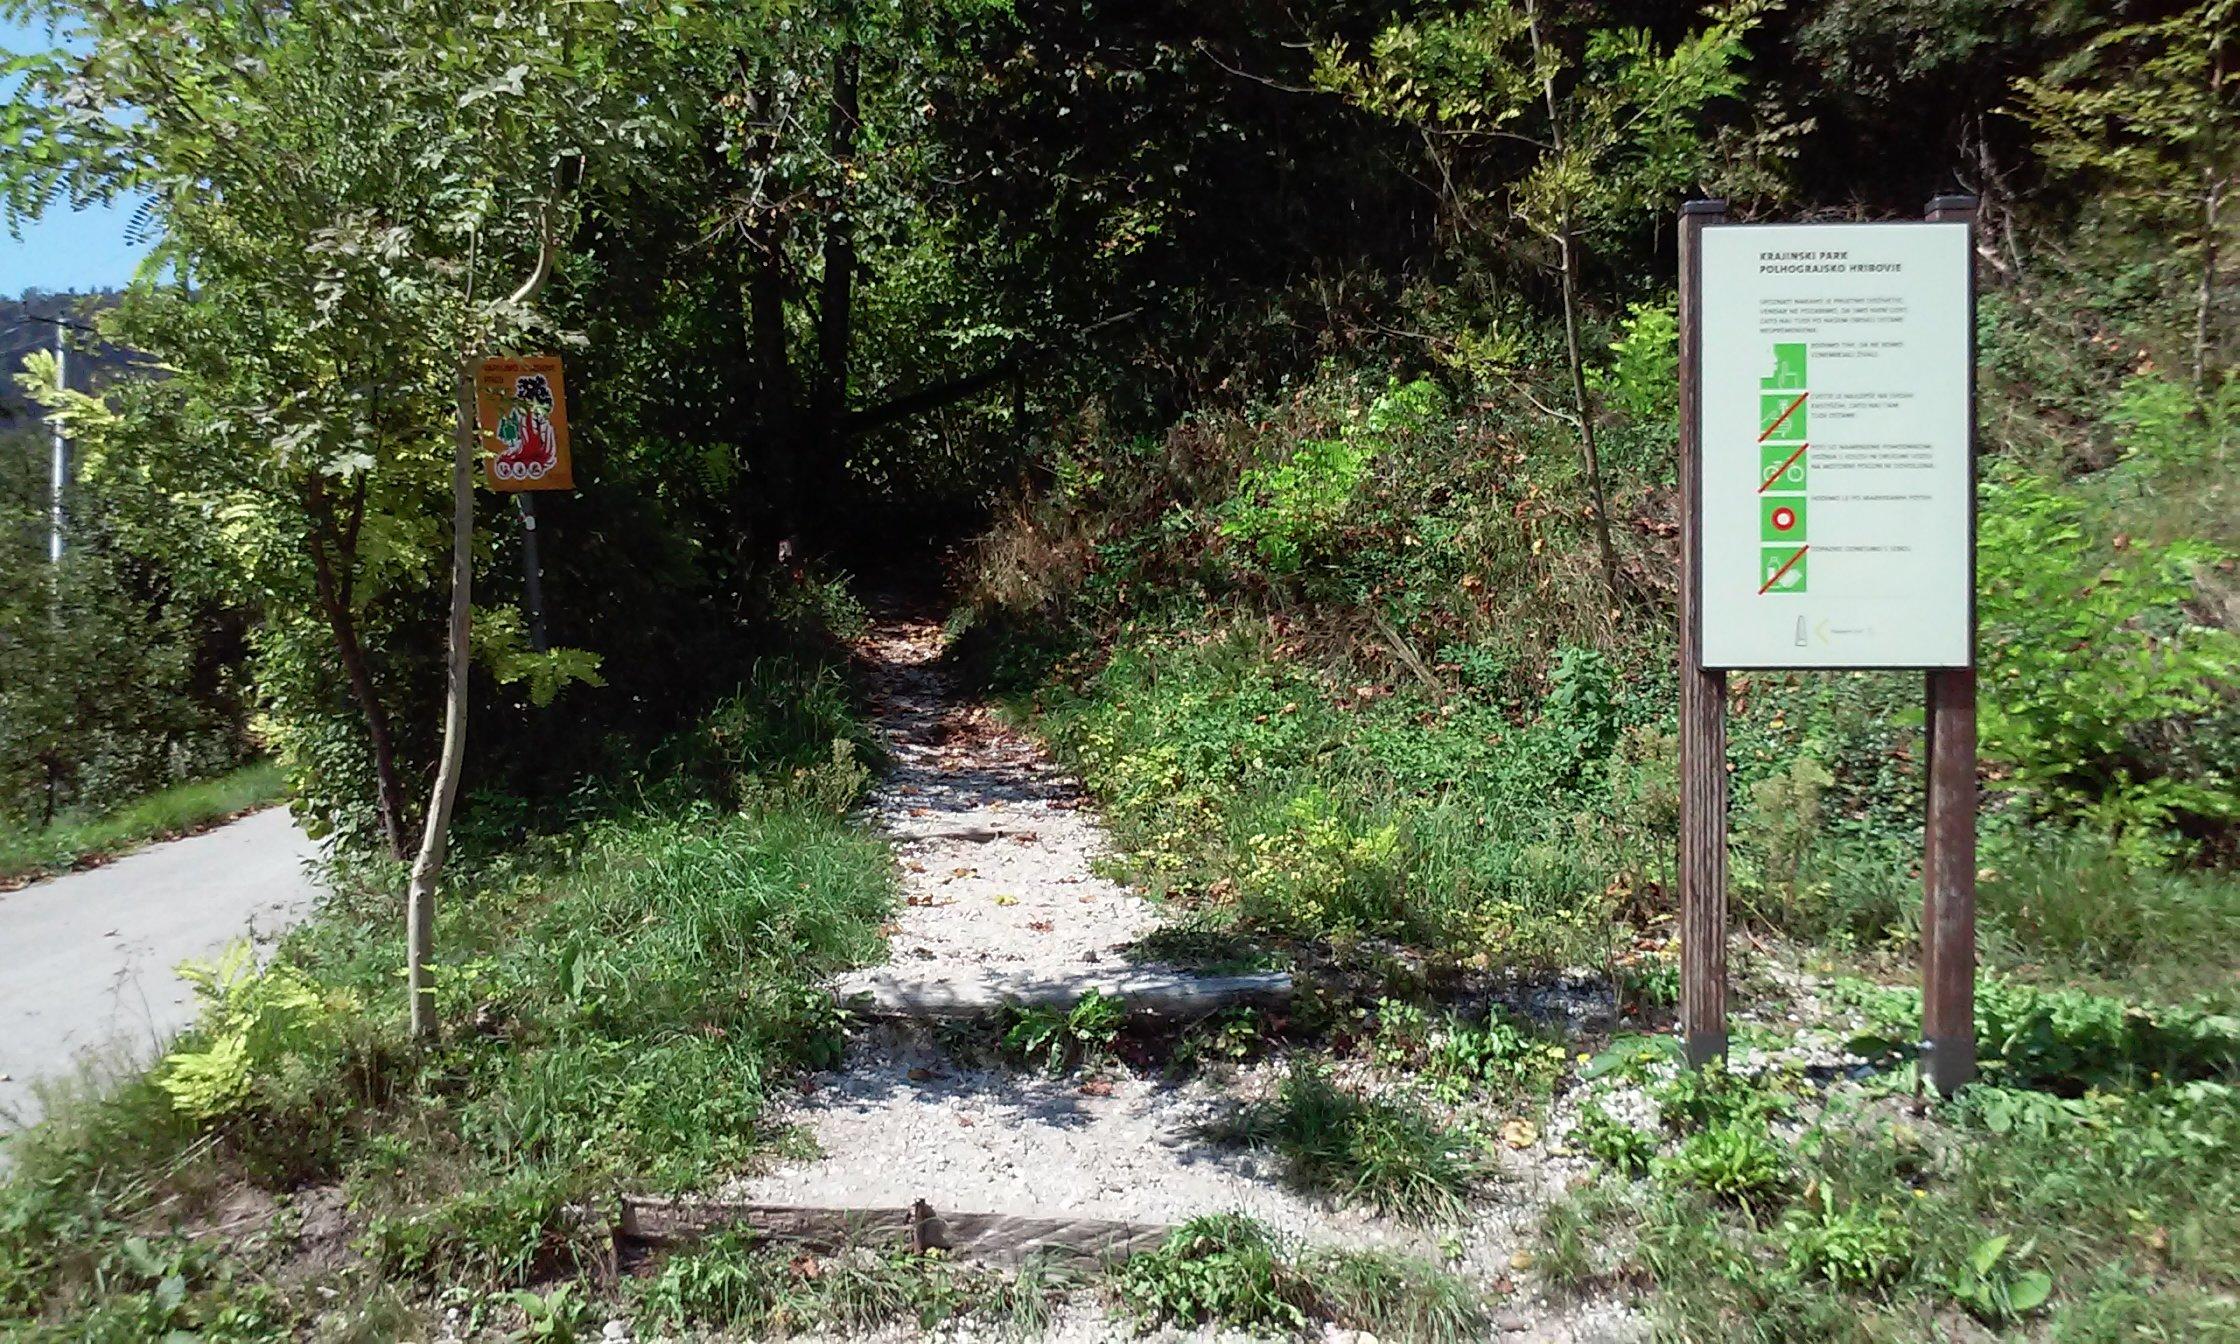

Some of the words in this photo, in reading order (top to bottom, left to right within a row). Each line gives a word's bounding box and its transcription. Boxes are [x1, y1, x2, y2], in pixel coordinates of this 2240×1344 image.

[1760, 252, 1815, 261] KRAJINSKI
[1819, 251, 1848, 260] PARK
[1759, 263, 1845, 273] POLHOGRAJSKO
[1849, 262, 1902, 272] HRIBOVJE
